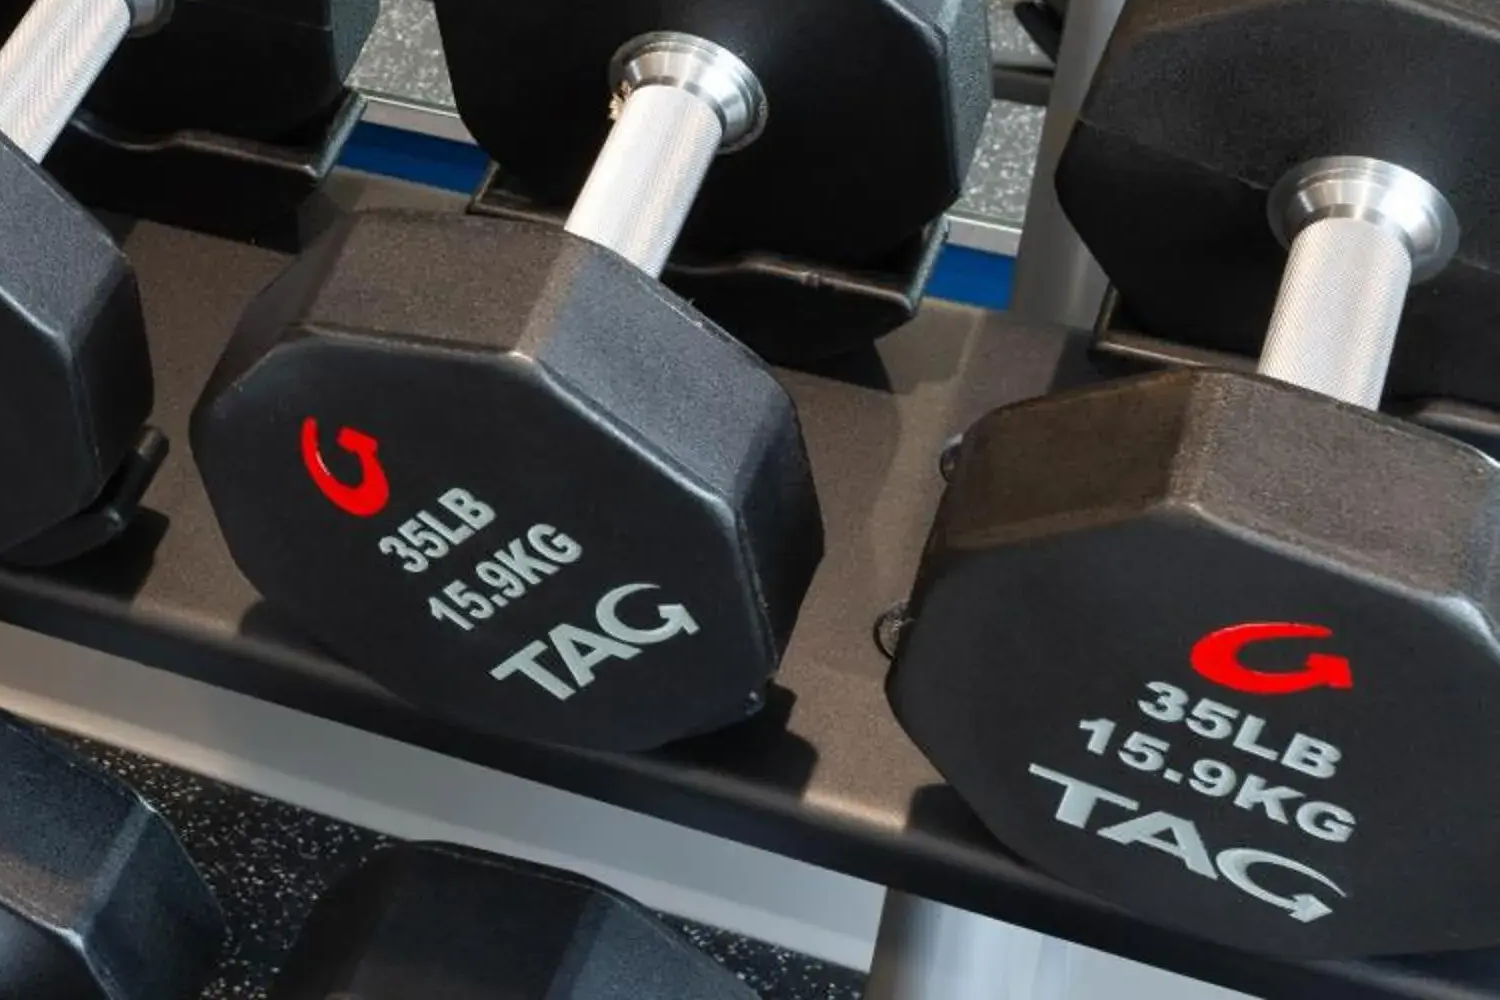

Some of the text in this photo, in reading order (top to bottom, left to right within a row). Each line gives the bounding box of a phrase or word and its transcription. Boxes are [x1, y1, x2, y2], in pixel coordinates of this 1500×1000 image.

[378, 487, 496, 573] 35LB
[428, 523, 582, 631] 15.9KG
[489, 582, 700, 701] TAG
[1078, 718, 1357, 843] 15.9KG
[1137, 681, 1342, 779] 35LB
[1027, 762, 1349, 923] TAG
